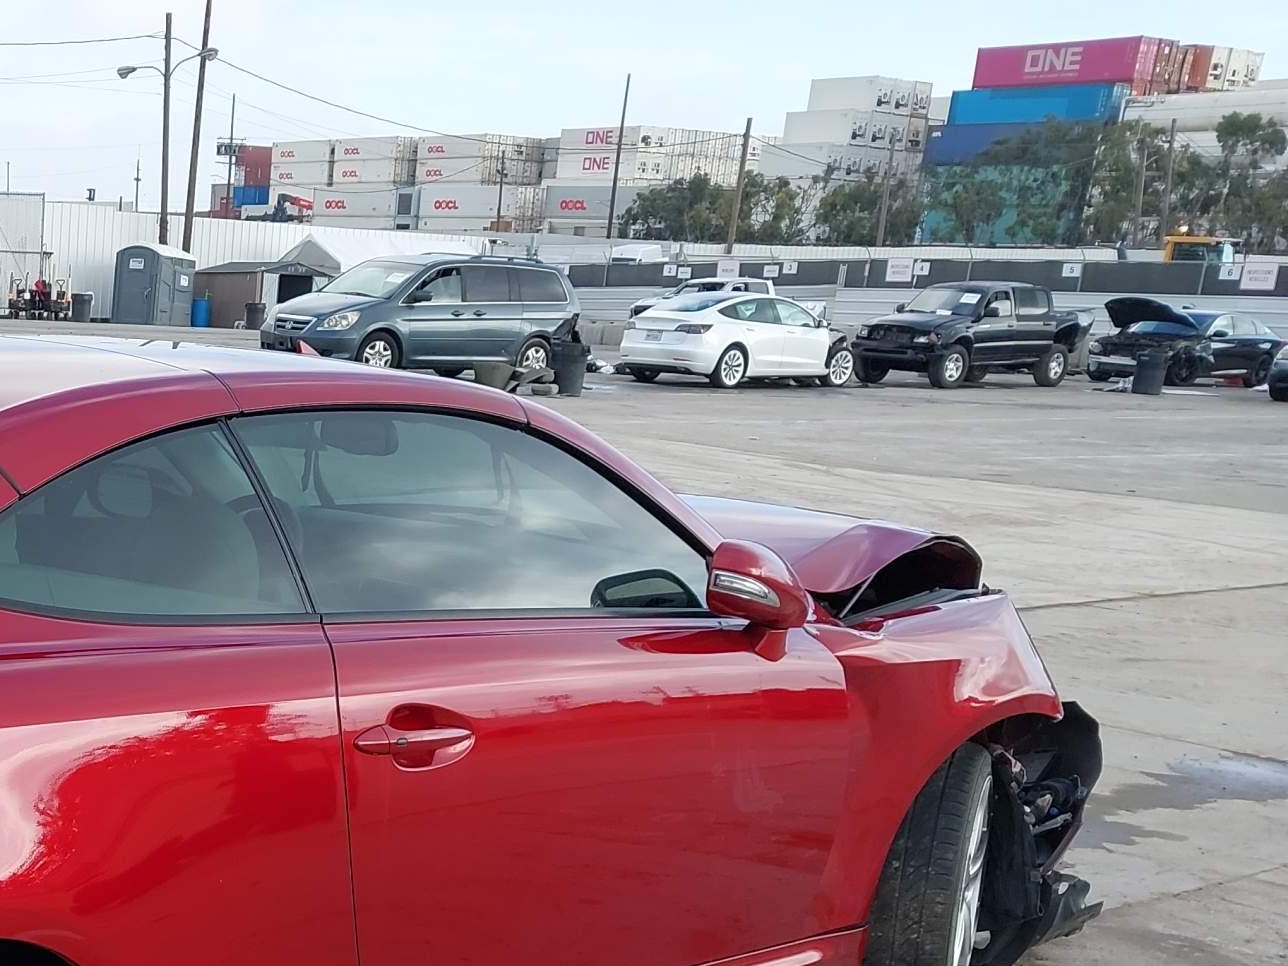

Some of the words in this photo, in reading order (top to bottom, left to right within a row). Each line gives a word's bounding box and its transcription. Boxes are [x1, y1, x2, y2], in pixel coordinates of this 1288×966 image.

[1024, 47, 1083, 72] ONE
[585, 130, 613, 145] ONE
[280, 150, 295, 158] OOCL
[344, 147, 360, 155] OOCL
[428, 146, 445, 154] OOCL
[582, 157, 610, 171] ONE
[279, 172, 293, 180] OOCL
[342, 170, 358, 178] OOCL
[426, 169, 443, 177] OOCL
[325, 200, 346, 209] OOCL
[434, 200, 459, 210] OOCL
[560, 200, 587, 210] OOCL
